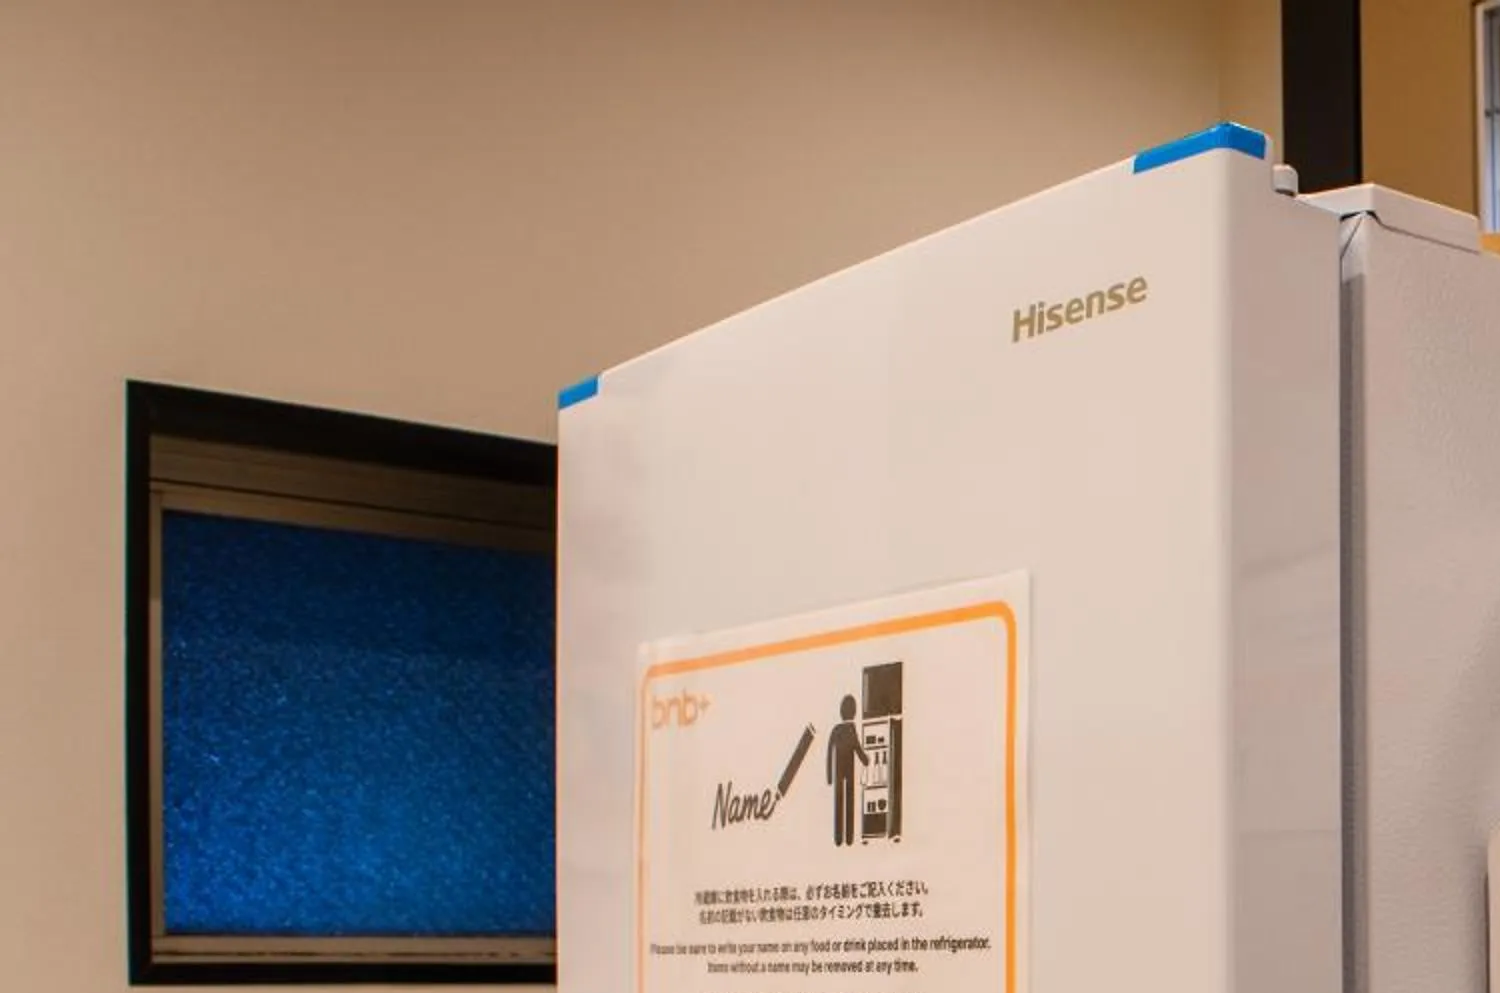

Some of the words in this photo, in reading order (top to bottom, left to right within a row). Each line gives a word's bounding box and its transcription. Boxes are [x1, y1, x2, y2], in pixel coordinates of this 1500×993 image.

[1012, 276, 1148, 343] Hisense
[712, 781, 777, 830] Name
[708, 944, 716, 954] to
[738, 943, 755, 956] your
[757, 943, 779, 953] name
[794, 943, 808, 956] any
[810, 939, 830, 952] food
[832, 941, 841, 951] or
[843, 938, 866, 952] drink
[867, 937, 899, 954] placed
[901, 937, 910, 951] in
[911, 937, 928, 950] the
[930, 936, 992, 953] refrigerator.
[768, 962, 789, 973] name
[791, 962, 810, 975] may
[824, 960, 863, 973] removed
[876, 962, 892, 975] any
[894, 960, 919, 973] time.
